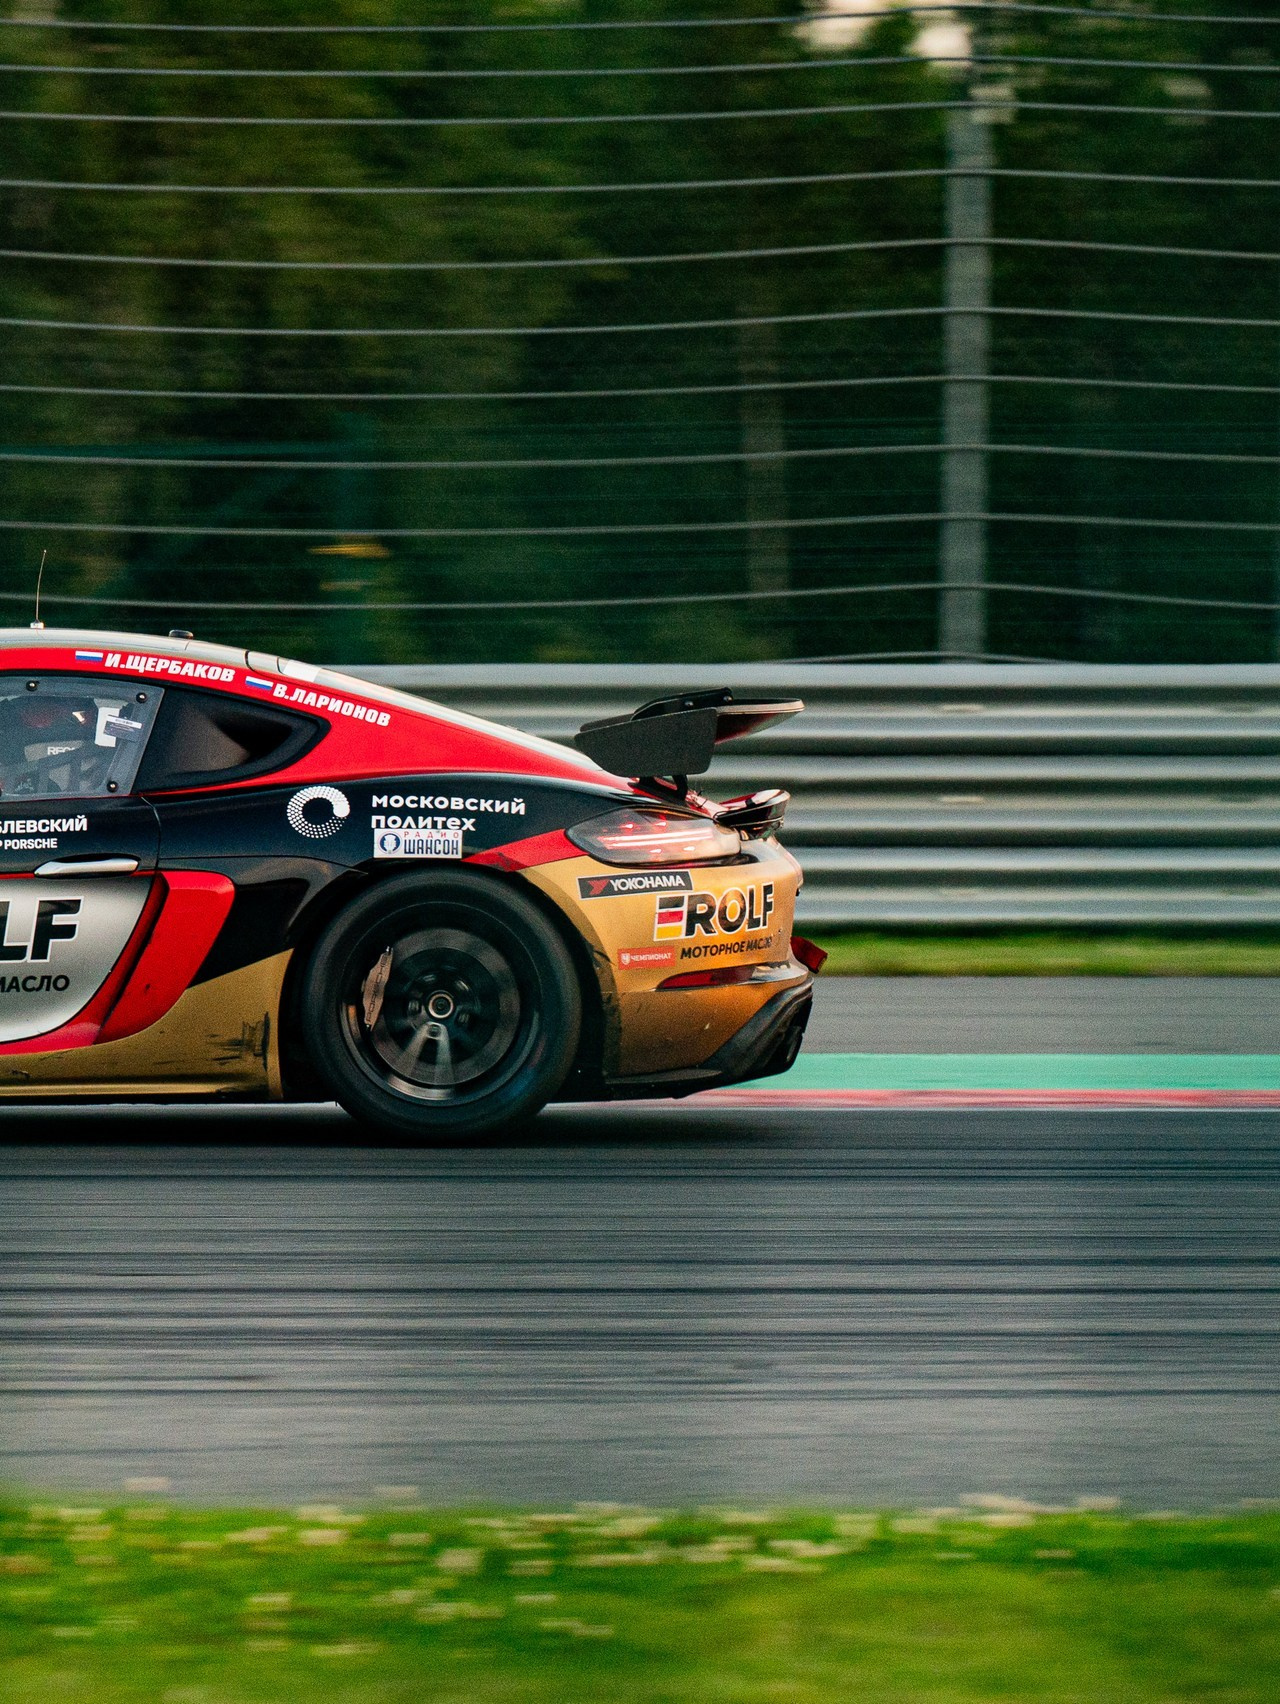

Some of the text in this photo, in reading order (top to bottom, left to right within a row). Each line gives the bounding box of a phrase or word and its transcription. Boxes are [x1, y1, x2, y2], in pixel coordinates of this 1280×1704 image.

[104, 653, 236, 683] И.ЩЕРБАКОВ
[273, 684, 391, 727] В.ЛАРИОНОВ
[4, 838, 58, 850] PORSCHE
[404, 839, 459, 855] ШАНСОН
[610, 875, 685, 892] YOKOHAMA
[685, 882, 775, 937] ROLF
[631, 953, 672, 961] ЧЕМПИОНАТ
[680, 941, 745, 960] МОТОРНОЕ
